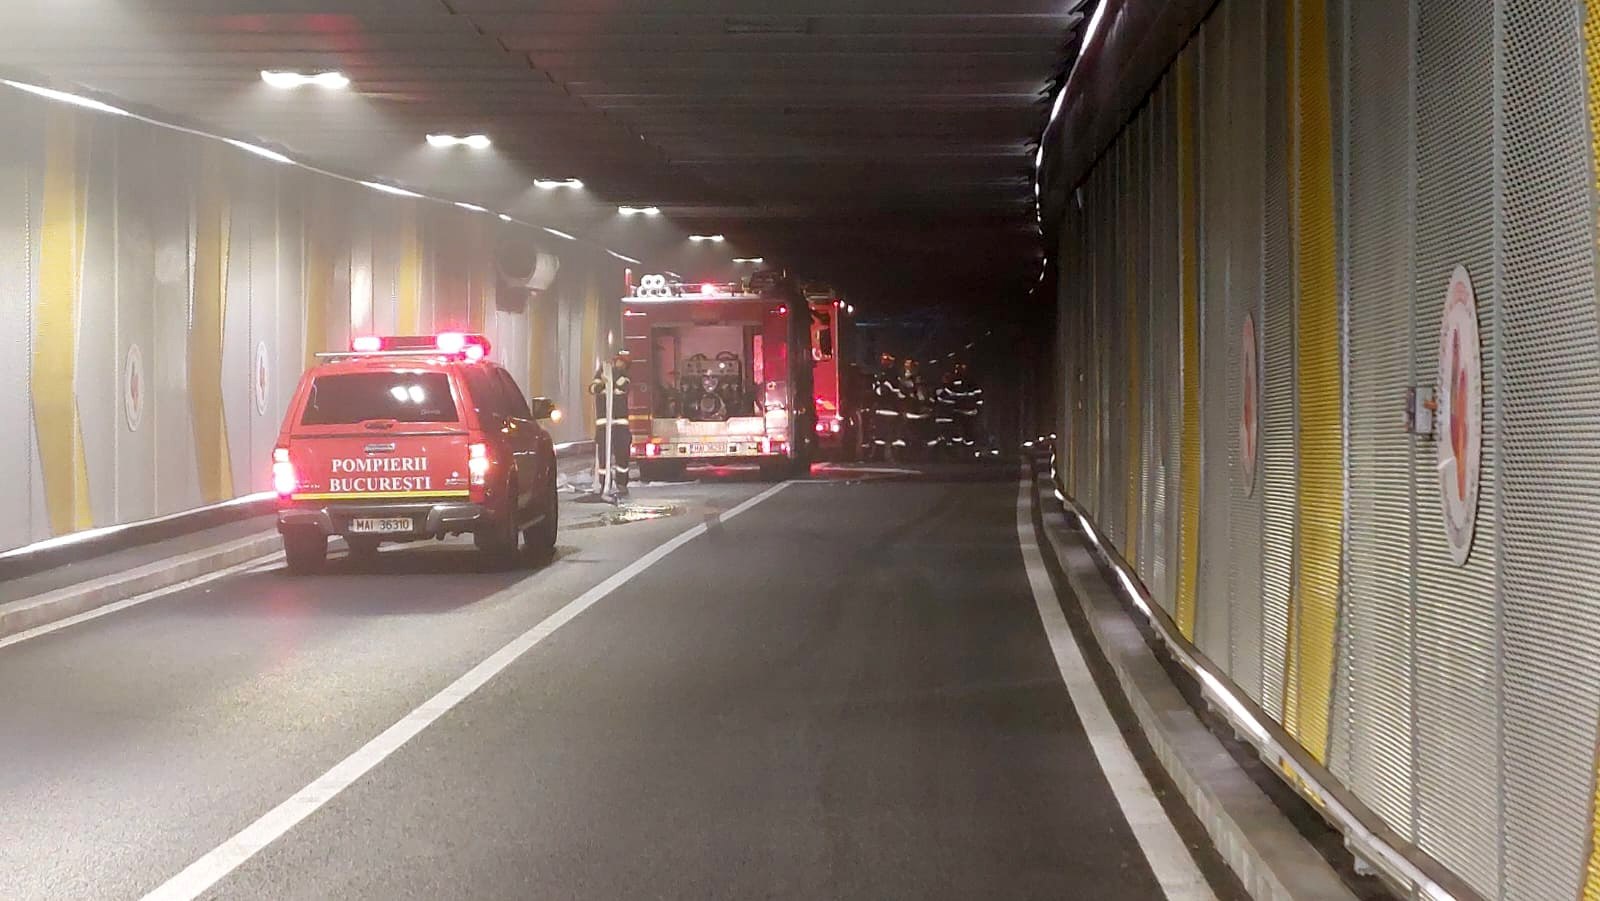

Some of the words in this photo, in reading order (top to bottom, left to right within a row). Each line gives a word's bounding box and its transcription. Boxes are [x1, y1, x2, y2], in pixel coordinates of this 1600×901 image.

[332, 457, 428, 473] POMPIERII
[356, 519, 374, 531] MAI
[379, 518, 410, 530] 36310
